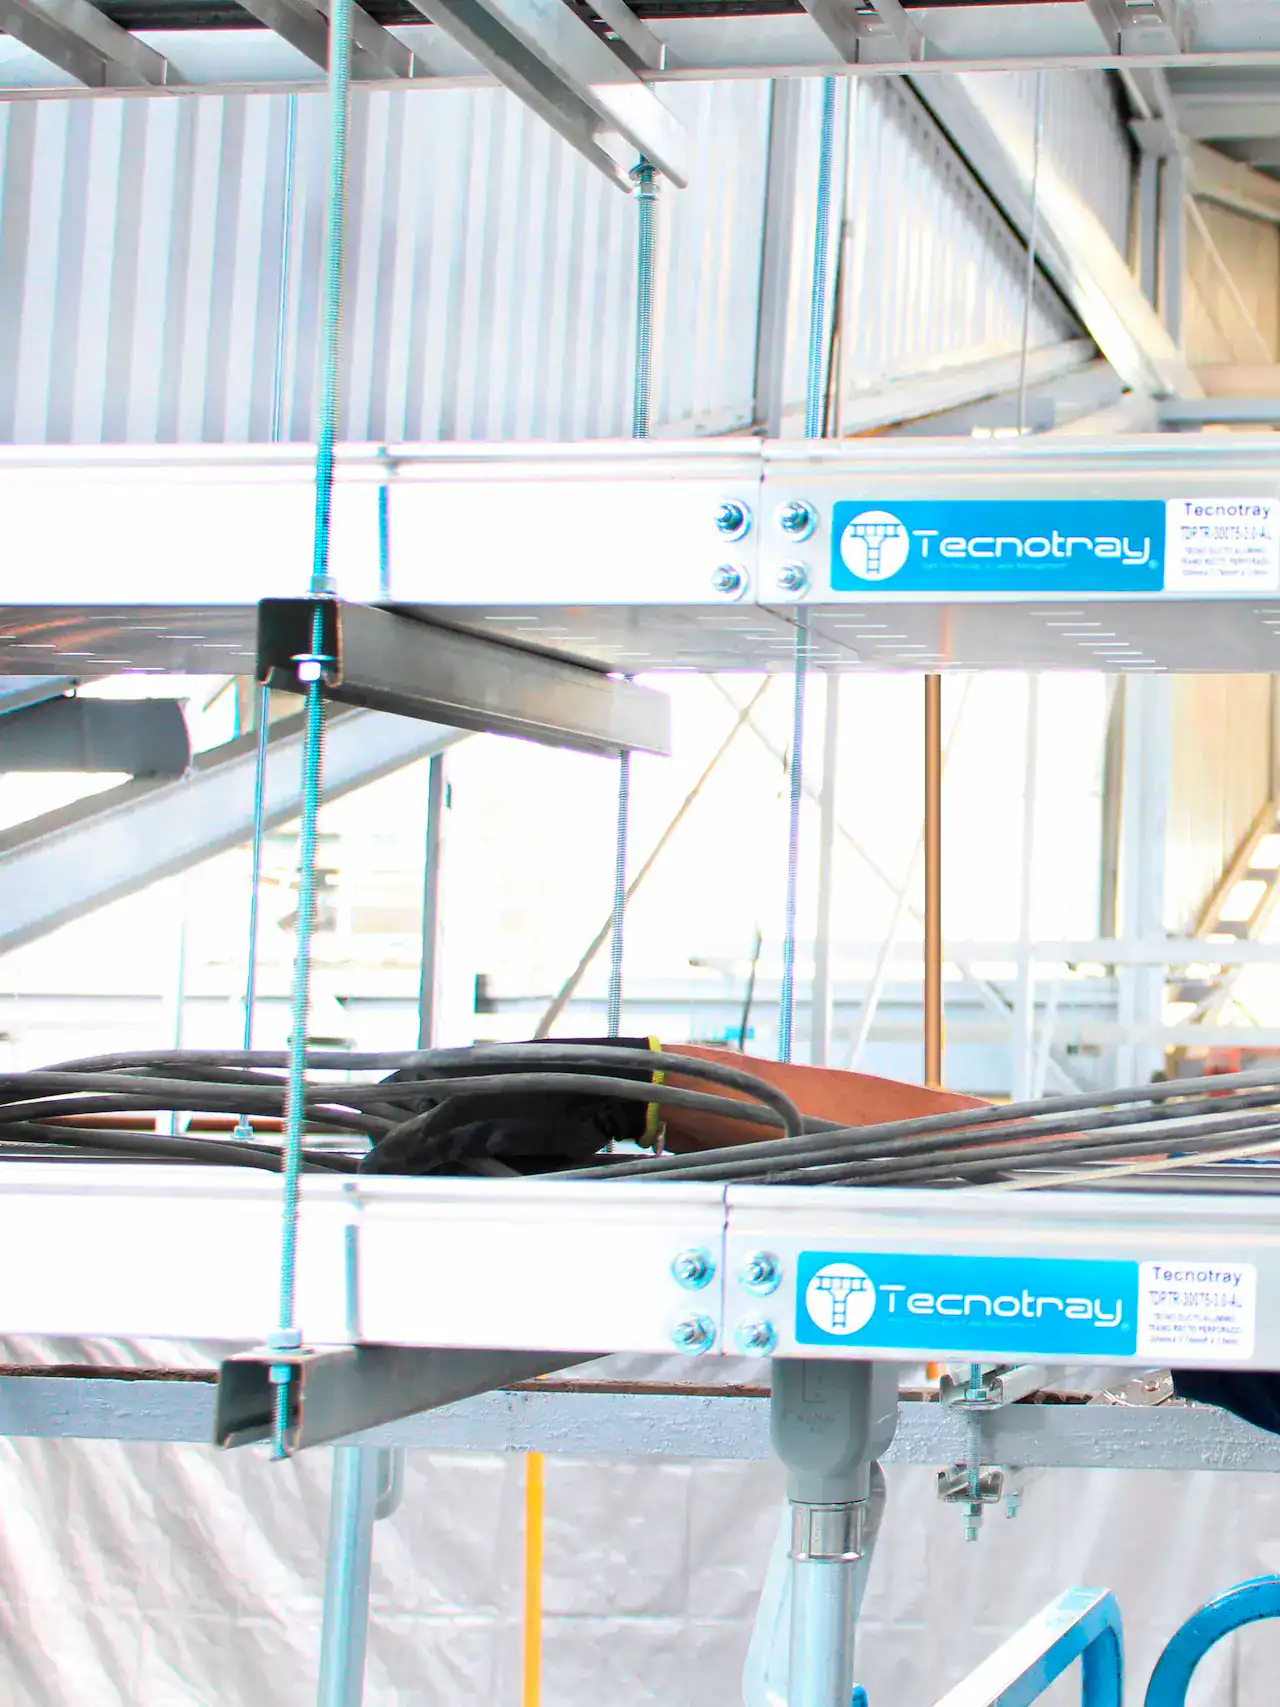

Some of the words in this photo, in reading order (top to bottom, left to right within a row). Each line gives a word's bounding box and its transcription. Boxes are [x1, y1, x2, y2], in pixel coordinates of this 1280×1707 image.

[1184, 502, 1271, 519] Tecnotray
[912, 530, 1150, 565] Tecnotray
[1153, 1266, 1243, 1287] Tecnotray
[879, 1285, 1122, 1328] Tecnotray
